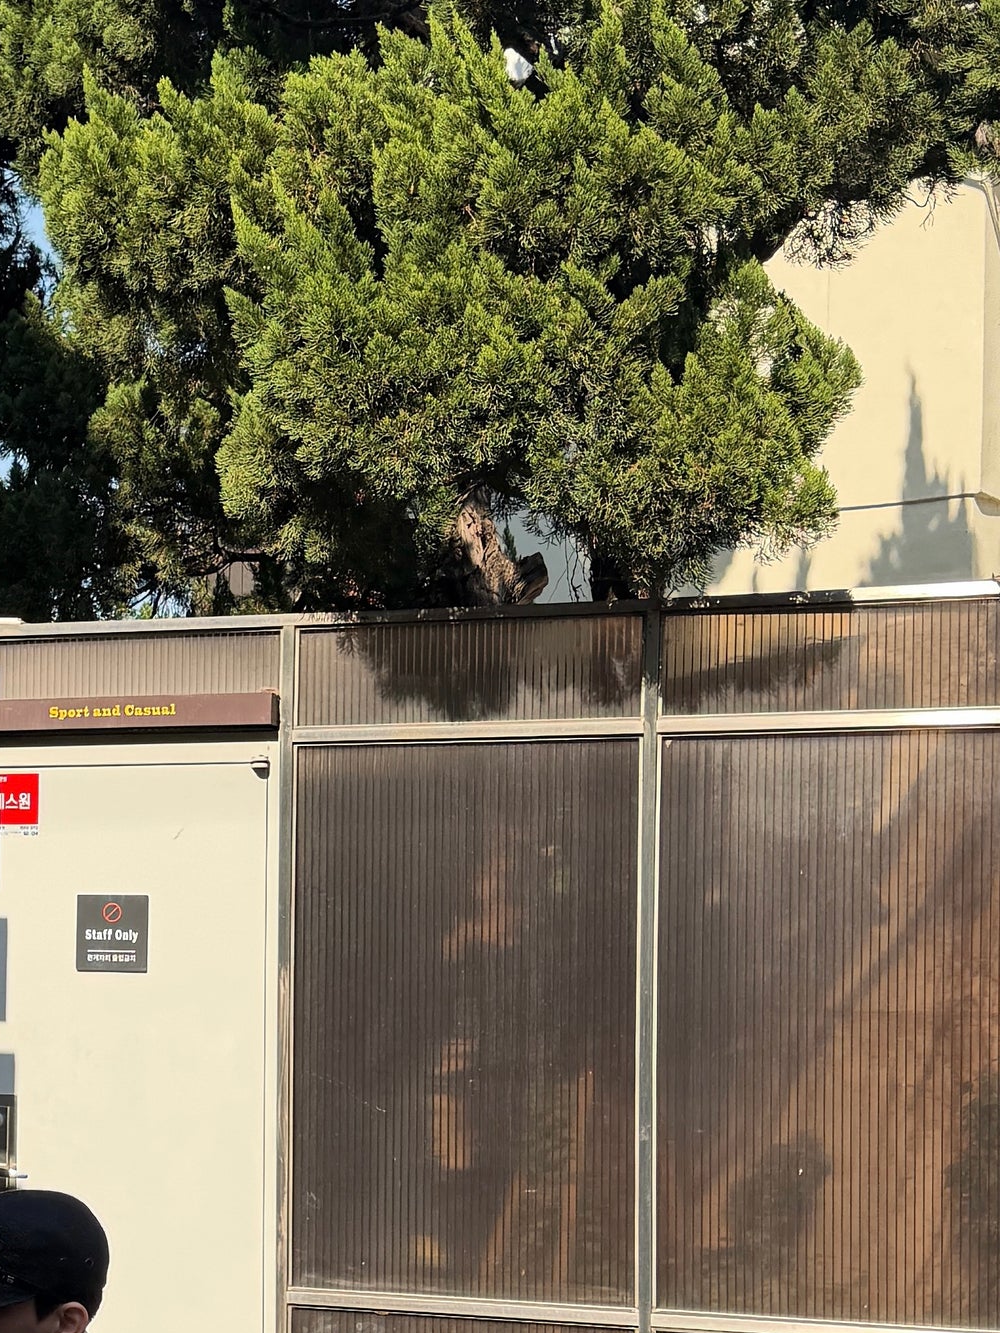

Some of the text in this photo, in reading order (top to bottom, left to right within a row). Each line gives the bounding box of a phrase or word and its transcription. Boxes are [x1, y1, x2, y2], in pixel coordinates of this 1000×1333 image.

[49, 703, 176, 720] Sport and Casual
[85, 928, 139, 944] Staff Only
